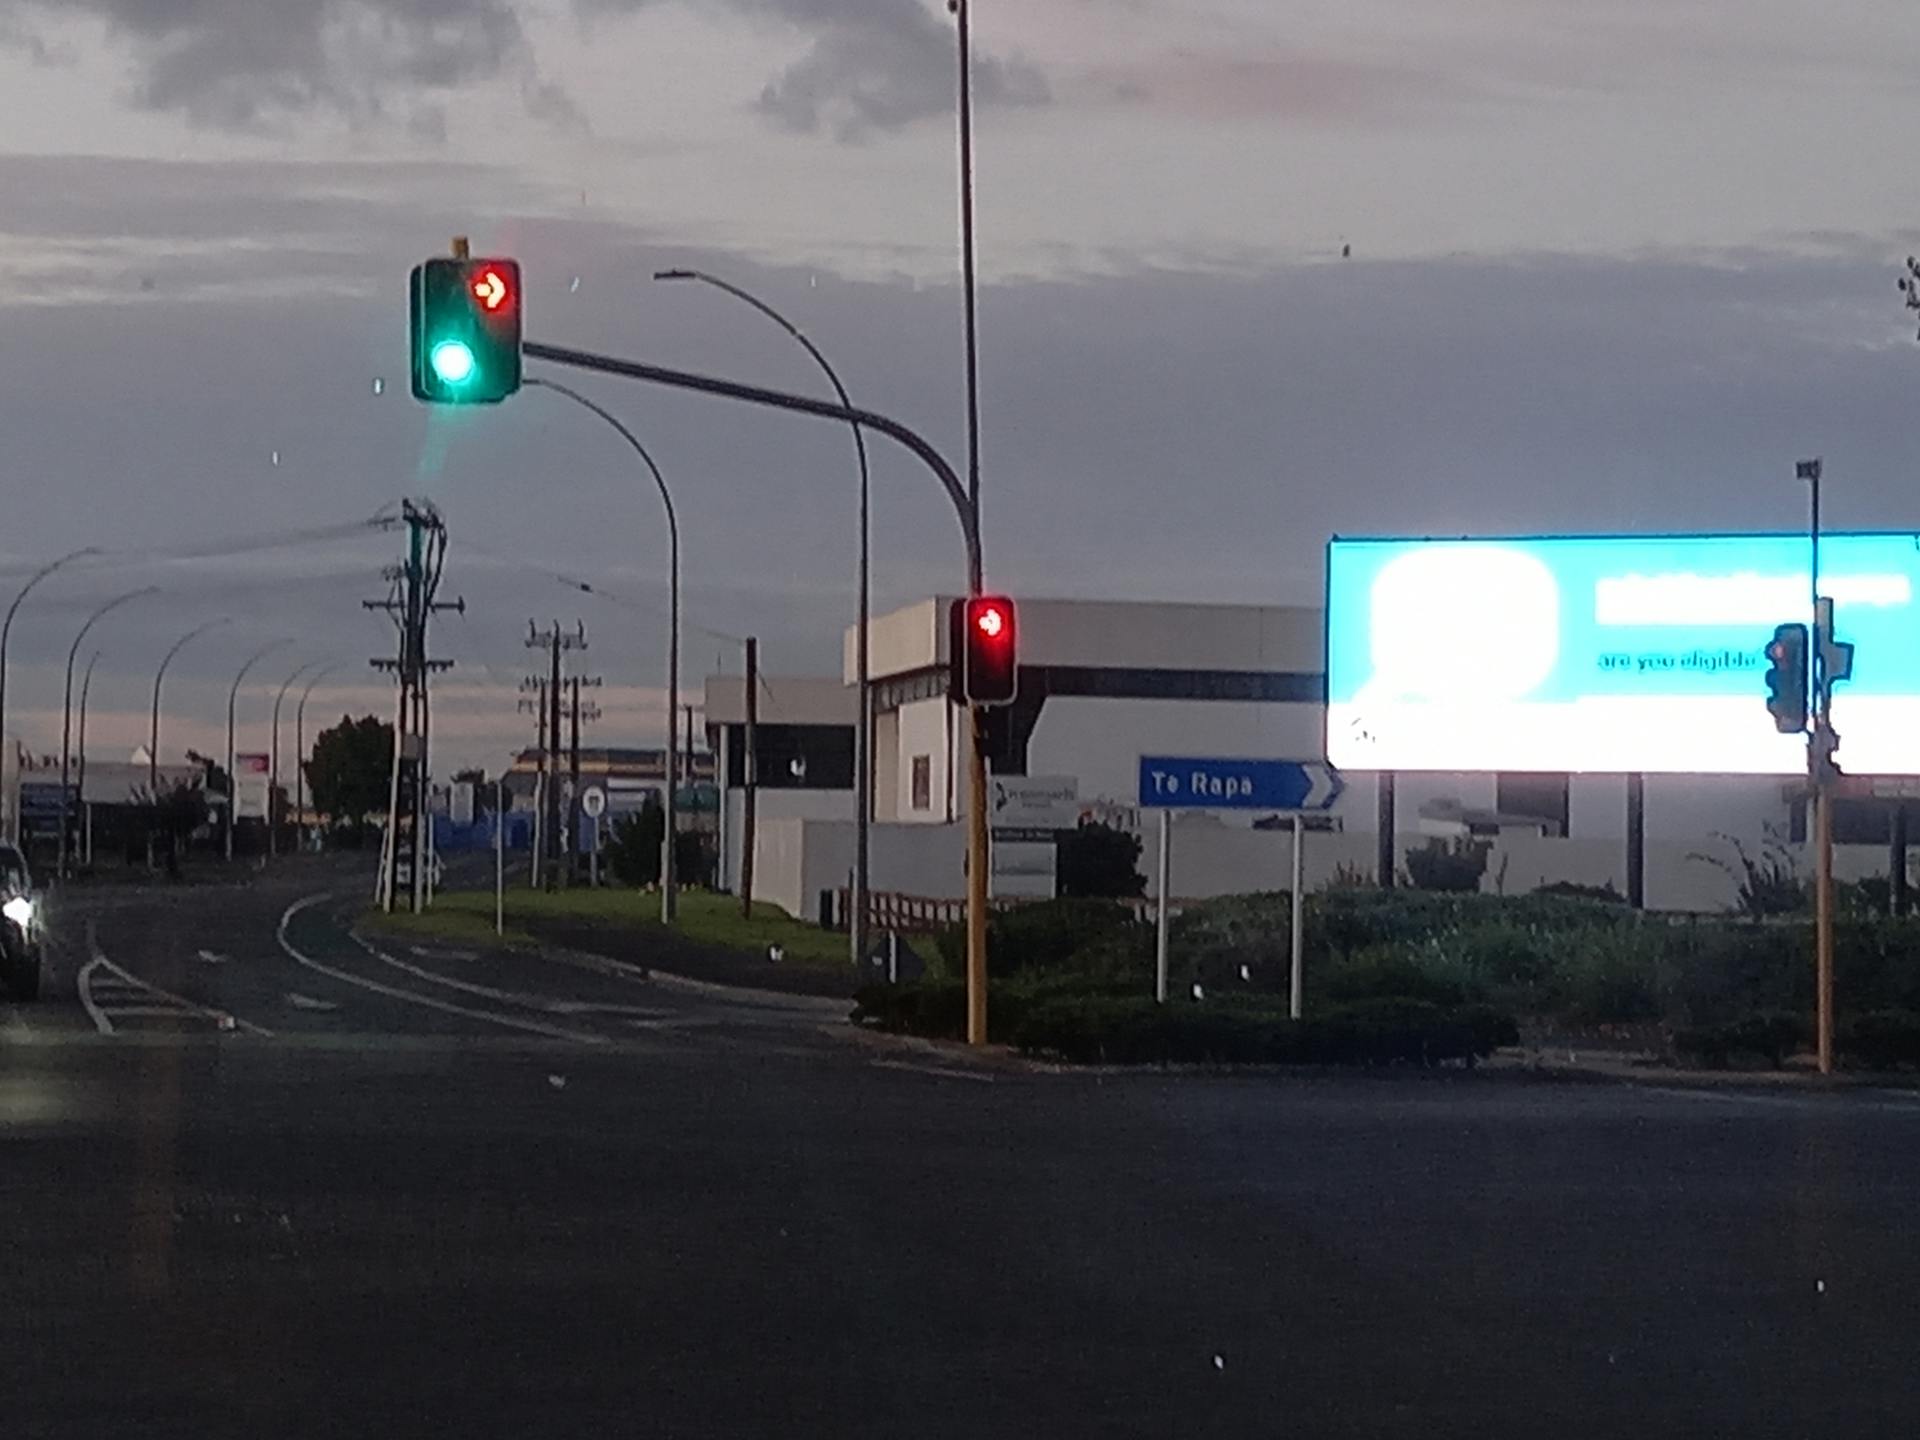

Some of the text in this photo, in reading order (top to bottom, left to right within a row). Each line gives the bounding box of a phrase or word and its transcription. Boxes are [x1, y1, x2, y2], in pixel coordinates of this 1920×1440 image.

[1637, 656, 1675, 671] you
[1152, 771, 1253, 799] Te Rapa
